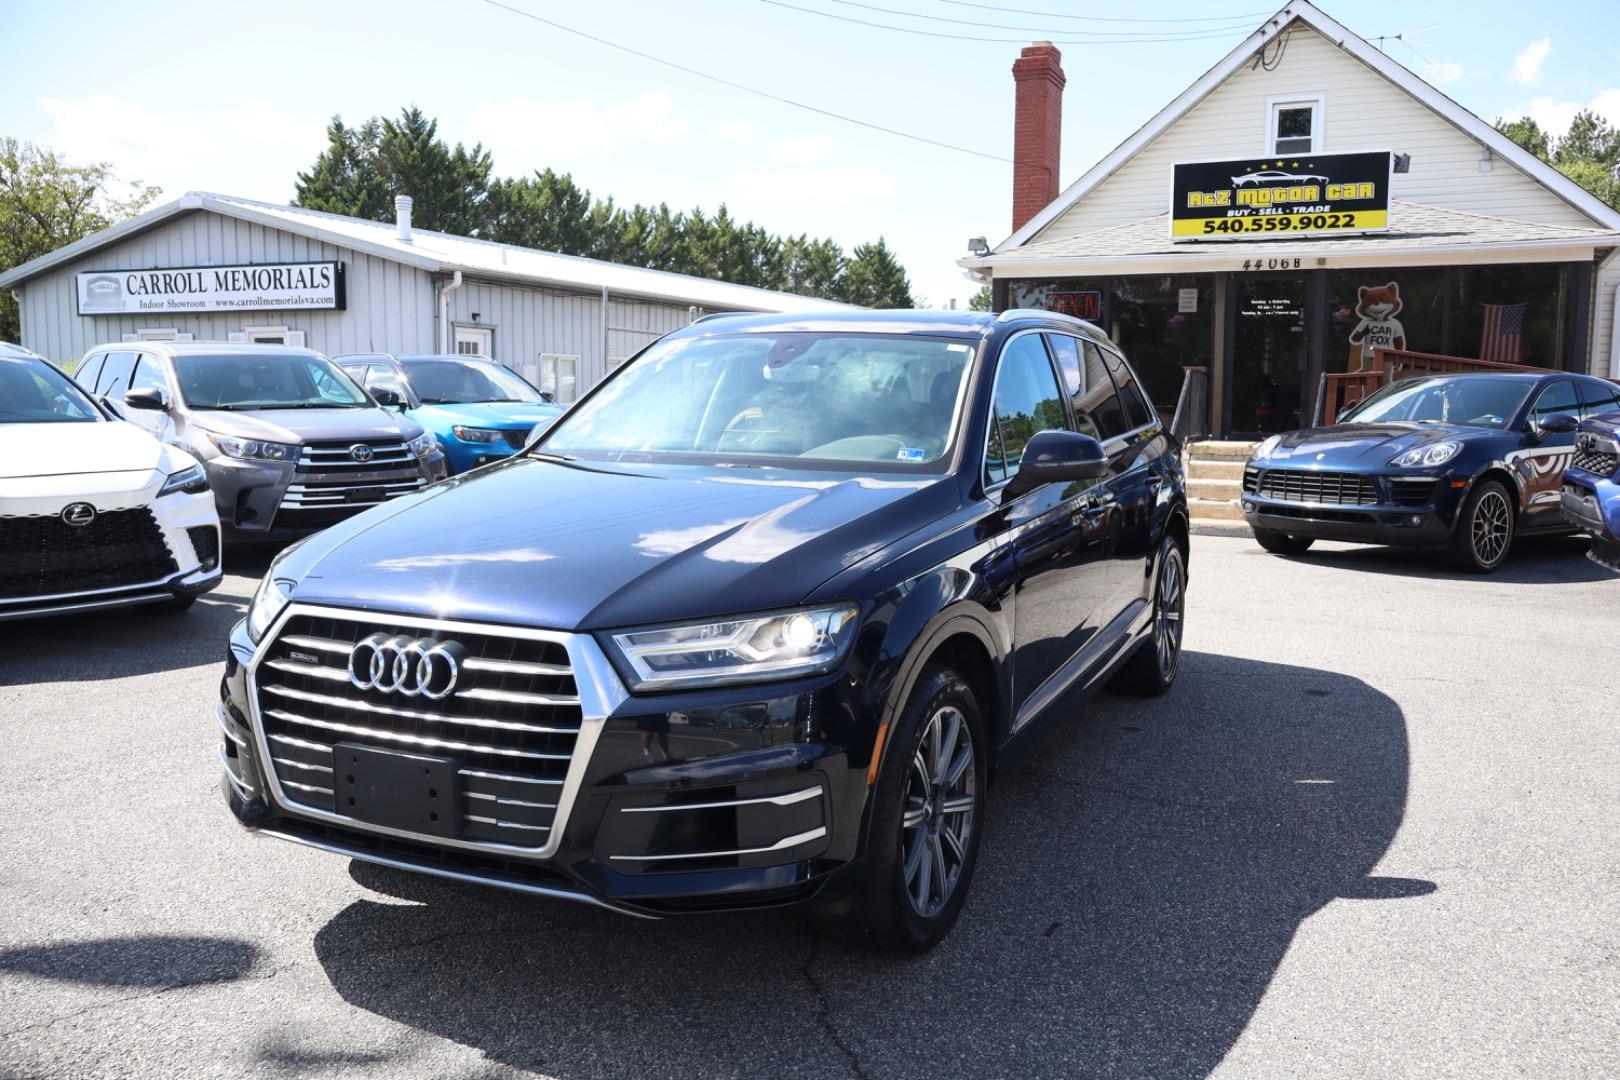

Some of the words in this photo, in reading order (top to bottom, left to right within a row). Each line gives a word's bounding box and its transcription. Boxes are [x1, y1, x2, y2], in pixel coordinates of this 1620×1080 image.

[1227, 209, 1251, 217] BUY
[1258, 207, 1284, 215] SELL
[1292, 205, 1331, 213] TRADE
[1203, 214, 1356, 234] 540.559.9022
[126, 272, 208, 295] CARROLL
[214, 266, 330, 292] MEMORIALS
[140, 299, 164, 309] Indoor
[166, 298, 206, 308] Showroom
[215, 295, 334, 307] www.carrollmemorialsva.com
[1046, 295, 1097, 317] OPEN
[1370, 325, 1392, 336] CAR
[1370, 335, 1391, 346] FOX
